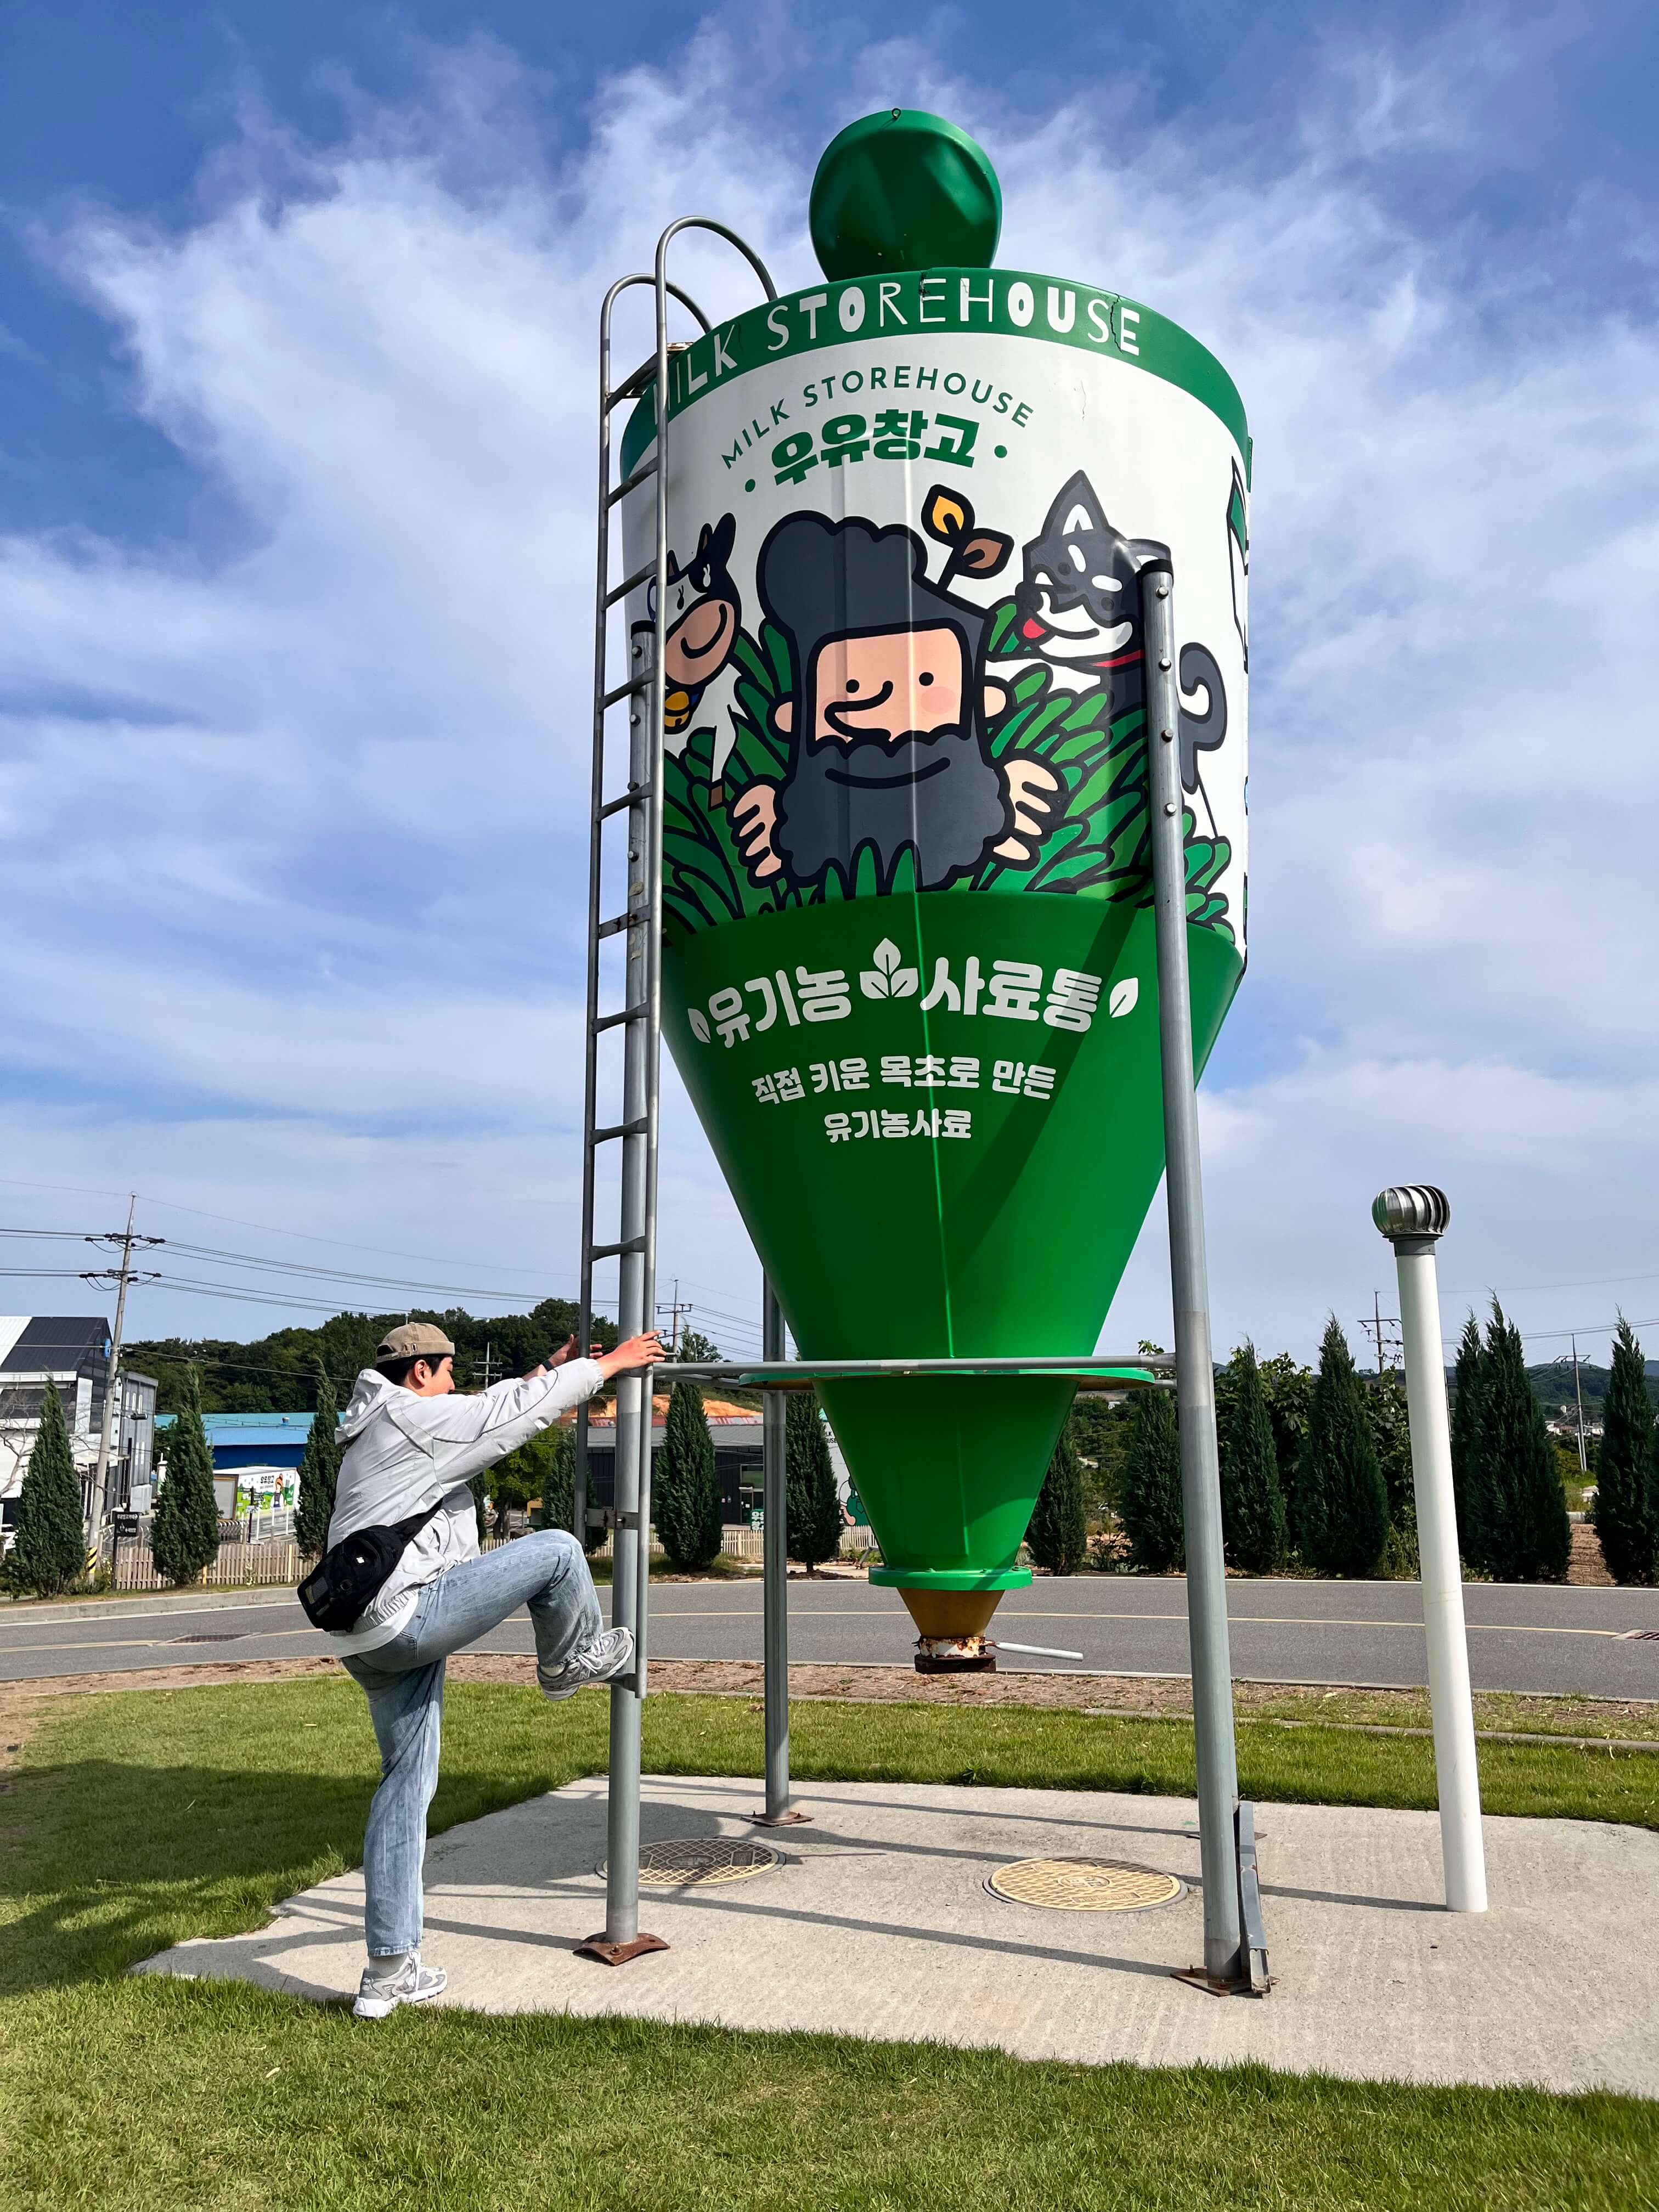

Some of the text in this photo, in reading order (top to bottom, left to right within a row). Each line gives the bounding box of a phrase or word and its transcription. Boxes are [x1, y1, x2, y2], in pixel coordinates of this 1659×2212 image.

[767, 278, 1141, 356] STOREHOUSE
[721, 366, 1034, 471] MILK STOREHOUSE
[770, 409, 979, 486] 우유창고
[708, 956, 1102, 1048] 유기농 사료통
[751, 1054, 1057, 1104] 직접 키운 목초로 만든
[824, 1108, 972, 1143] 유기농사료
